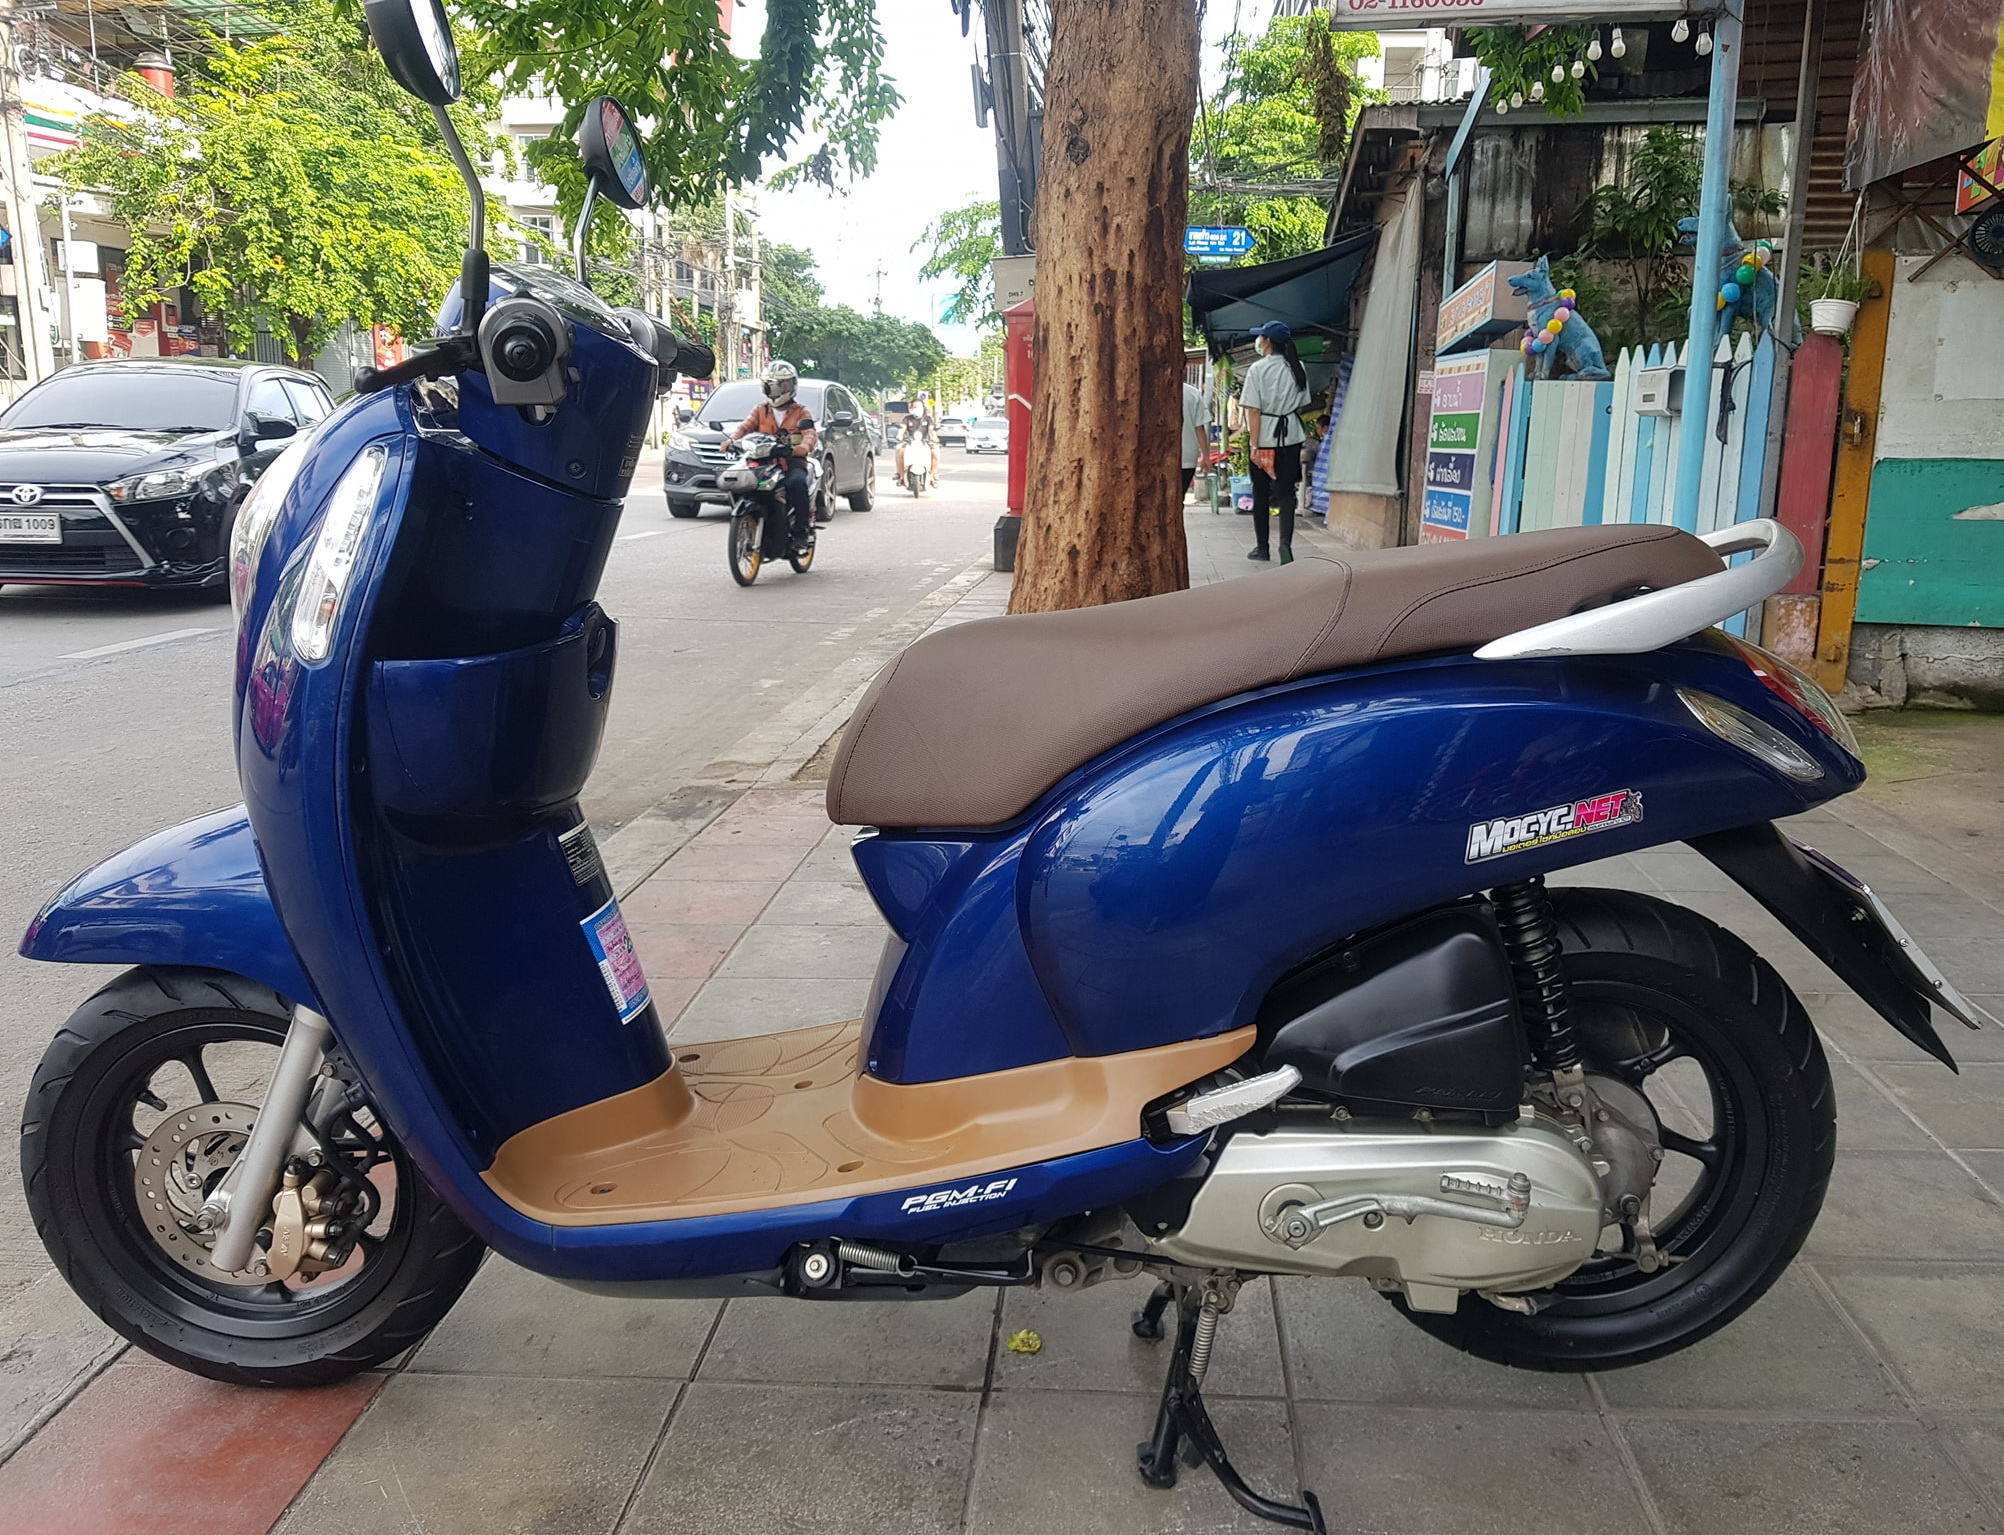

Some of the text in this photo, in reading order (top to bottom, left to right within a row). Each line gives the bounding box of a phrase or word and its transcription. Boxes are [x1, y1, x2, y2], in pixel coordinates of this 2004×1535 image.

[1232, 230, 1246, 246] 21
[25, 518, 55, 530] 1009
[901, 1178, 1018, 1210] PGM-FI
[907, 1191, 1007, 1215] FUEL INJECTION
[1479, 1226, 1582, 1245] HONDA
